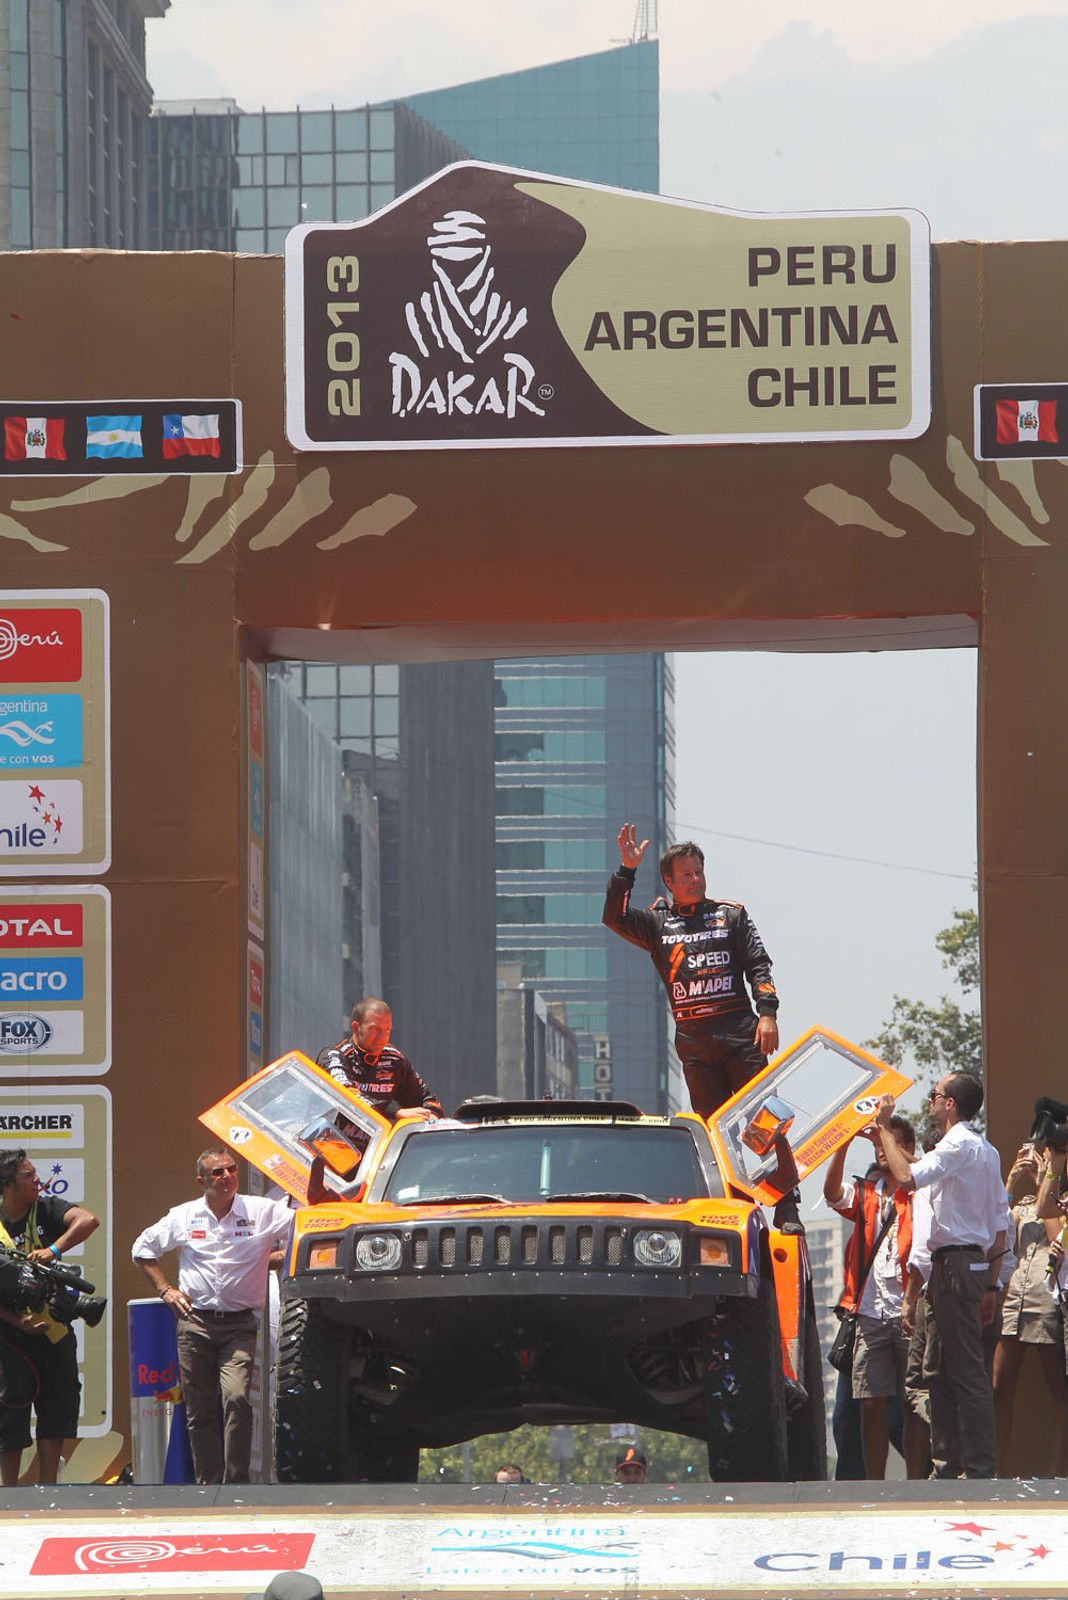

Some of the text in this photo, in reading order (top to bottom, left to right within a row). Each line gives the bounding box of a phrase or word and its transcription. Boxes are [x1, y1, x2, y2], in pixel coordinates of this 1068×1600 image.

[748, 244, 897, 287] PERU
[326, 255, 361, 417] 2013
[583, 304, 899, 351] ARGENTINA
[747, 364, 898, 408] CHILE
[9, 756, 29, 764] con
[32, 754, 55, 763] vos
[687, 950, 731, 969] SPEED
[0, 970, 68, 991] acro
[1, 1021, 38, 1038] FOX
[1, 1037, 39, 1045] SPORTS
[137, 1361, 175, 1385] Red
[437, 1527, 626, 1540] Argentina
[571, 1566, 640, 1574] vos
[753, 1550, 996, 1572] Chile
